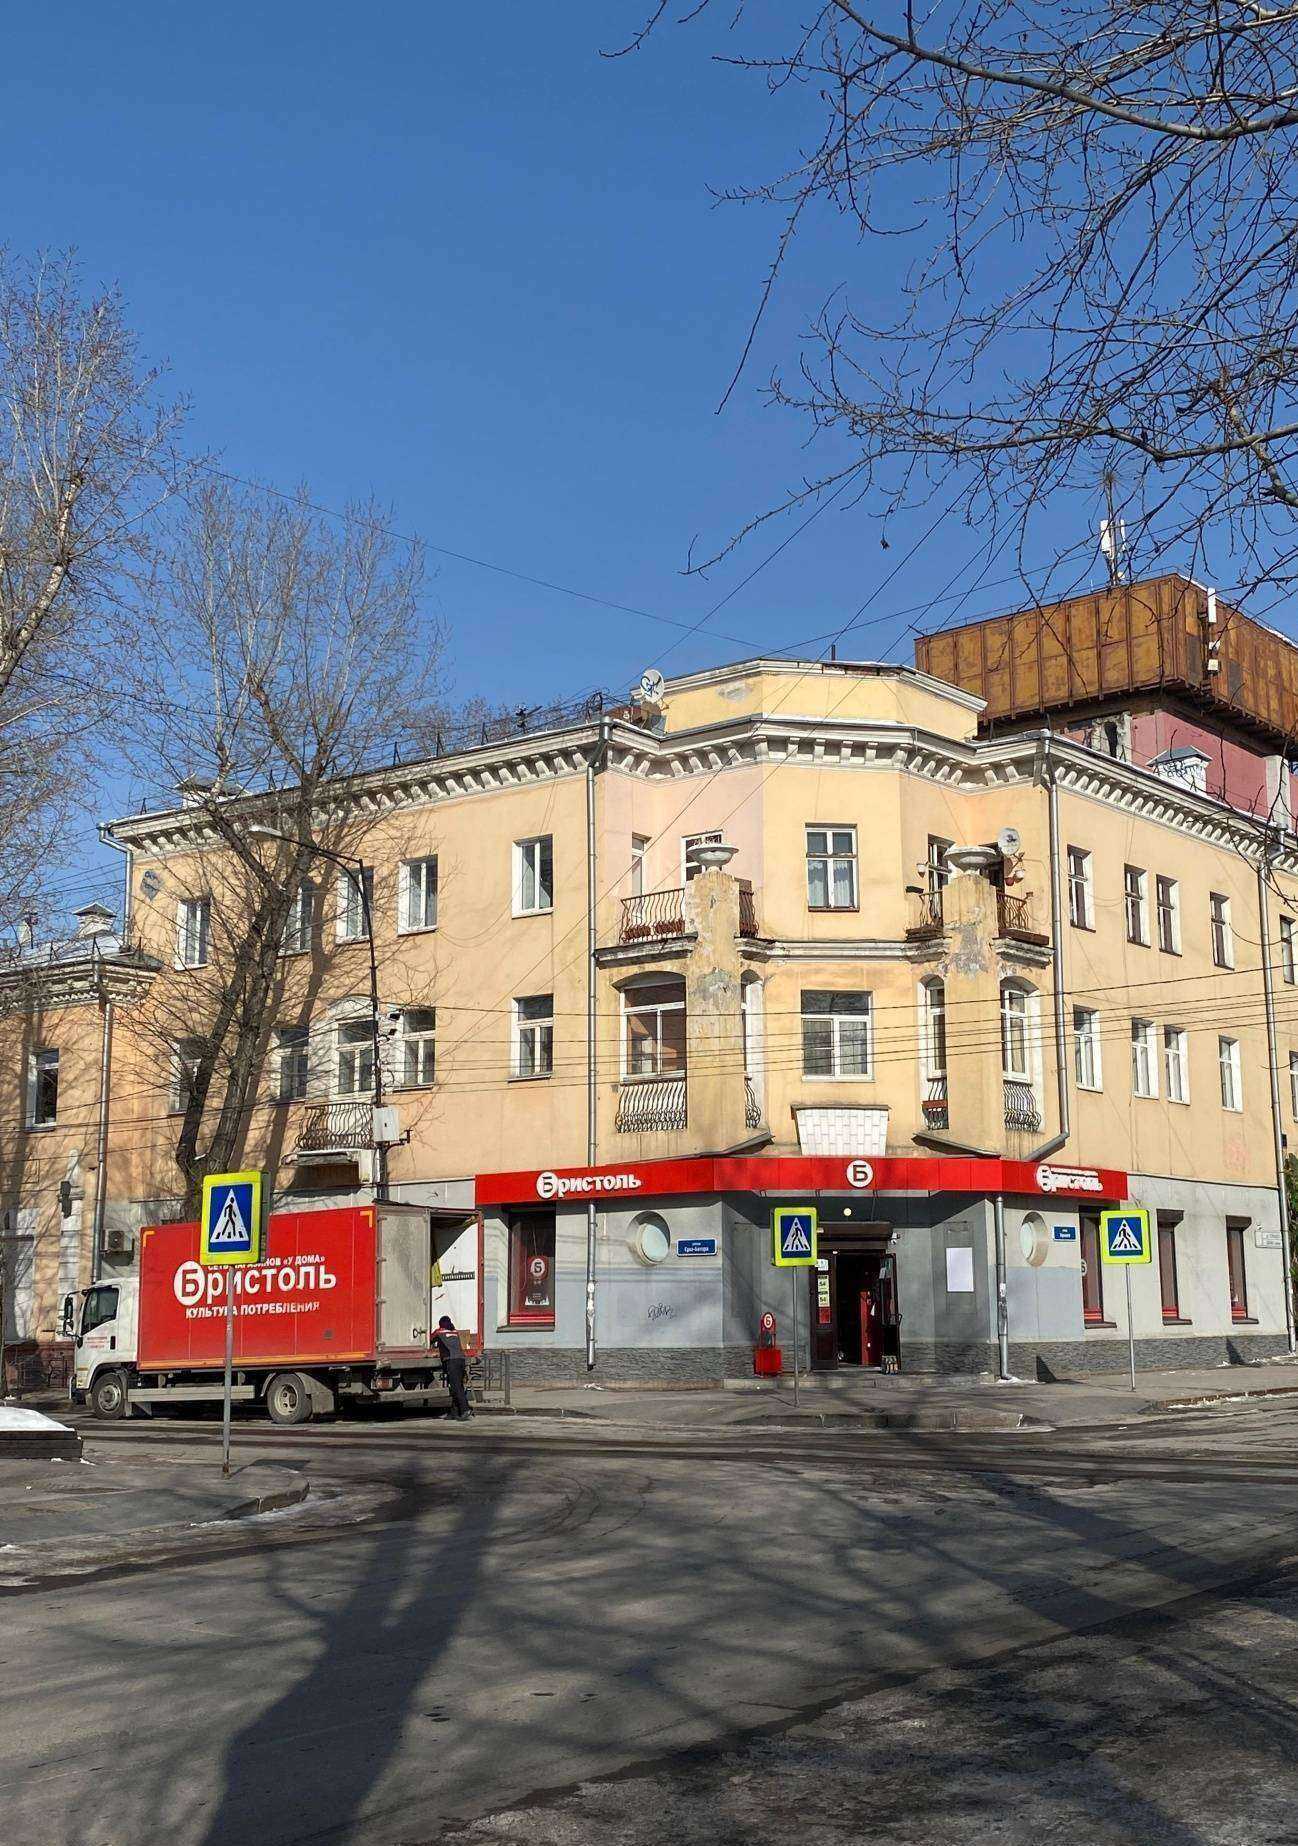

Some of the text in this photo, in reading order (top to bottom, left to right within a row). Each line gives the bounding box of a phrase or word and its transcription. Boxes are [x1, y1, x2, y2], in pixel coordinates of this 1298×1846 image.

[852, 1164, 869, 1182] Б
[536, 1171, 642, 1199] Бристоль
[174, 1260, 337, 1306] Бристоль
[240, 1301, 320, 1316] ПОТРЕБЛЕНИЯ
